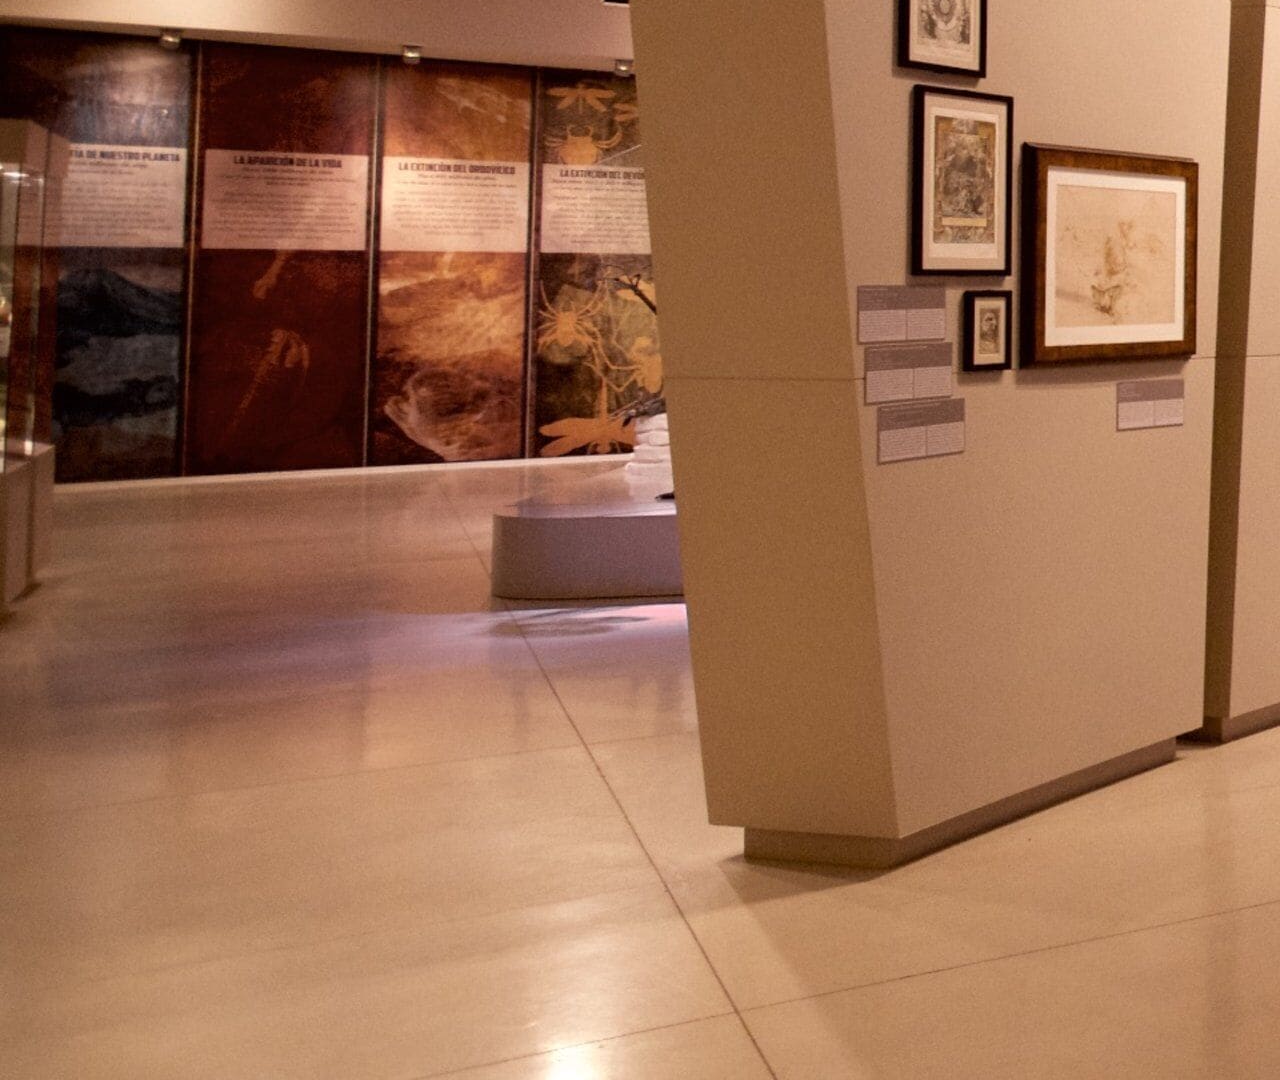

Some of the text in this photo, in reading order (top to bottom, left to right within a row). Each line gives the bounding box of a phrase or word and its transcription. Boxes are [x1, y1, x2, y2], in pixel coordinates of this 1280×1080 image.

[142, 151, 180, 162] PLANETA
[233, 155, 245, 165] LA
[296, 157, 307, 167] DE
[309, 158, 320, 168] LA
[398, 162, 409, 171] LA
[453, 164, 467, 173] DEL
[559, 169, 569, 178] LA
